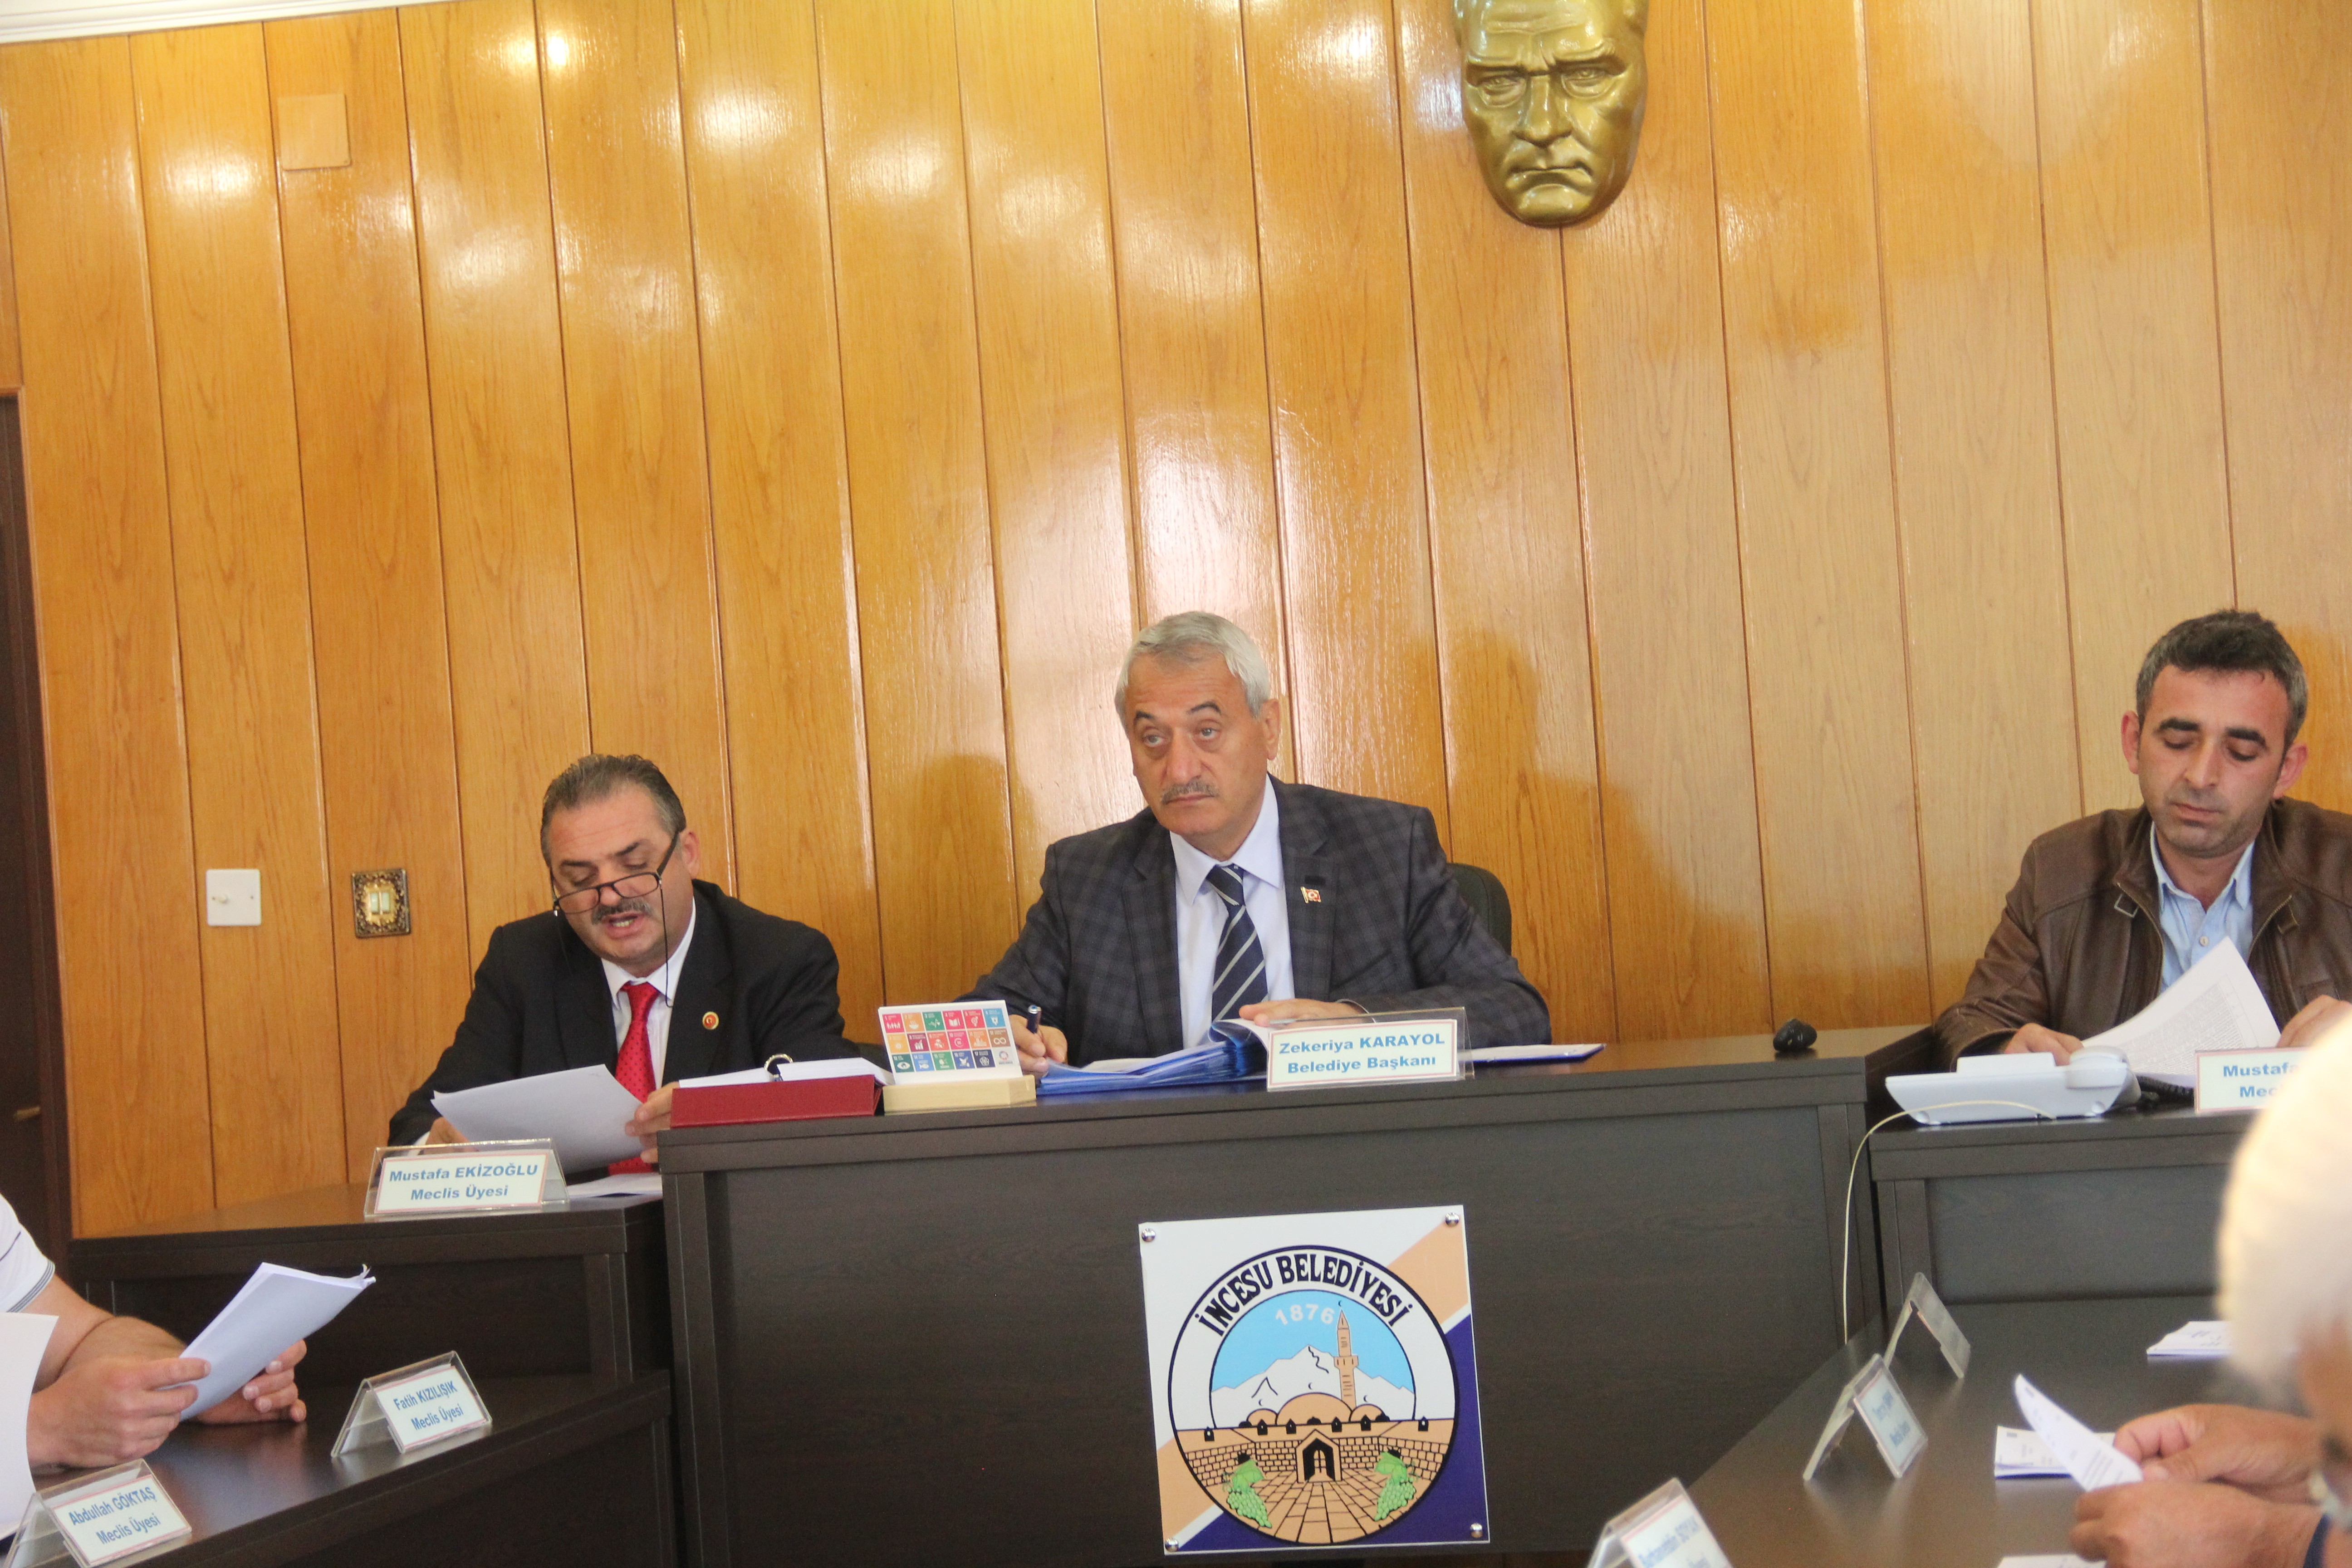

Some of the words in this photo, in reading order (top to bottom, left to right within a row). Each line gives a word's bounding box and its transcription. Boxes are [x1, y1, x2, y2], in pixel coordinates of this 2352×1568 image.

[1279, 1039, 1353, 1054] Zekeriya
[1360, 1033, 1445, 1049] KARAYOL
[1288, 1058, 1361, 1073] Belediye
[1367, 1055, 1436, 1070] Başkanı
[2239, 1085, 2278, 1098] Mec
[389, 1167, 450, 1181] Mustafa
[455, 1162, 538, 1178] EKİZOĞLU
[411, 1187, 460, 1200] Meclis
[466, 1184, 508, 1200] Üyesi
[1194, 1260, 1274, 1337] İNCESU
[1275, 1254, 1413, 1327] BELEDİYESİ
[1275, 1303, 1335, 1326] 1876
[393, 1394, 418, 1411] Fatih
[416, 1380, 458, 1403] KIZILIŞIK
[411, 1414, 440, 1430] Meclis
[438, 1403, 464, 1422] Üyesi
[68, 1501, 114, 1525] Abdullah
[112, 1486, 157, 1510] GÖKTAŞ
[95, 1524, 132, 1544] Meclis
[129, 1513, 161, 1534] Üyesi
